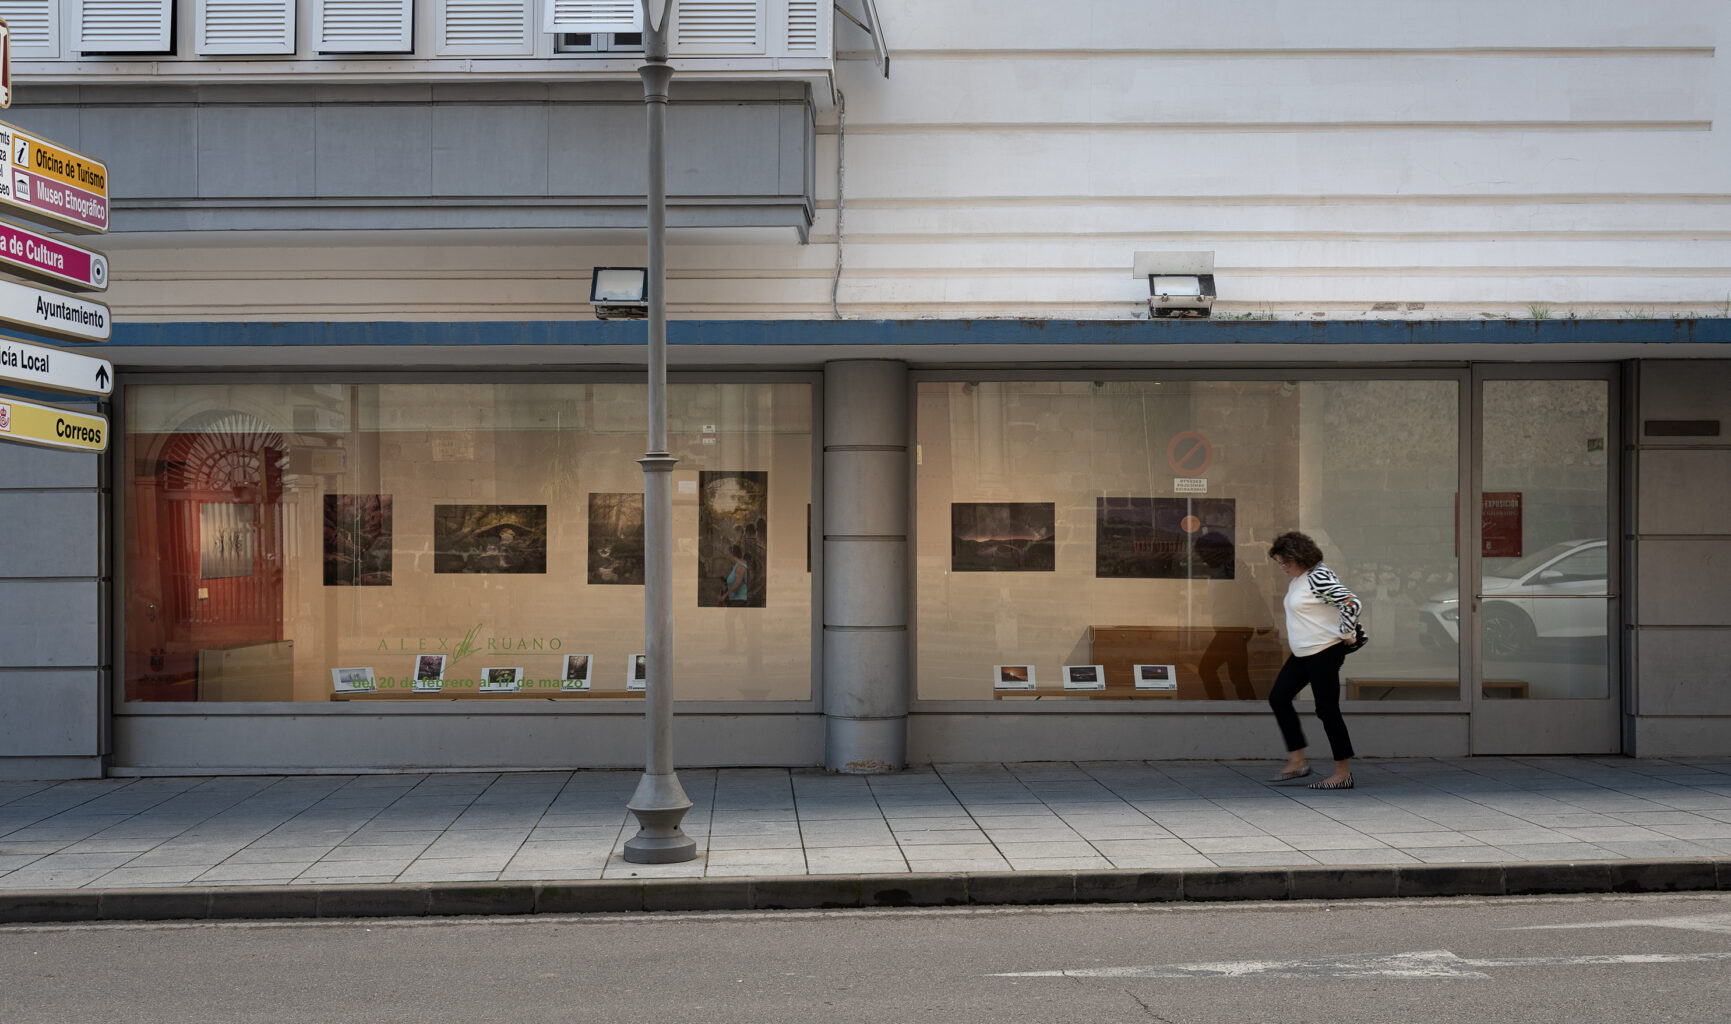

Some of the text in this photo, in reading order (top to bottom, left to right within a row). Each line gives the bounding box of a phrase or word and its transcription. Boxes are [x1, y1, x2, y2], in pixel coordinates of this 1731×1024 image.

[36, 148, 104, 189] Oficina de Turismo
[36, 180, 105, 220] Museo Etnográfico
[9, 234, 24, 257] de
[26, 240, 64, 270] Cultura
[36, 295, 104, 328] Ayuntamiento
[21, 349, 50, 373] Local
[56, 418, 101, 443] Correos
[377, 637, 562, 650] ALEX RUANO
[352, 675, 583, 689] del 20 de febrero al 17 de marzo
